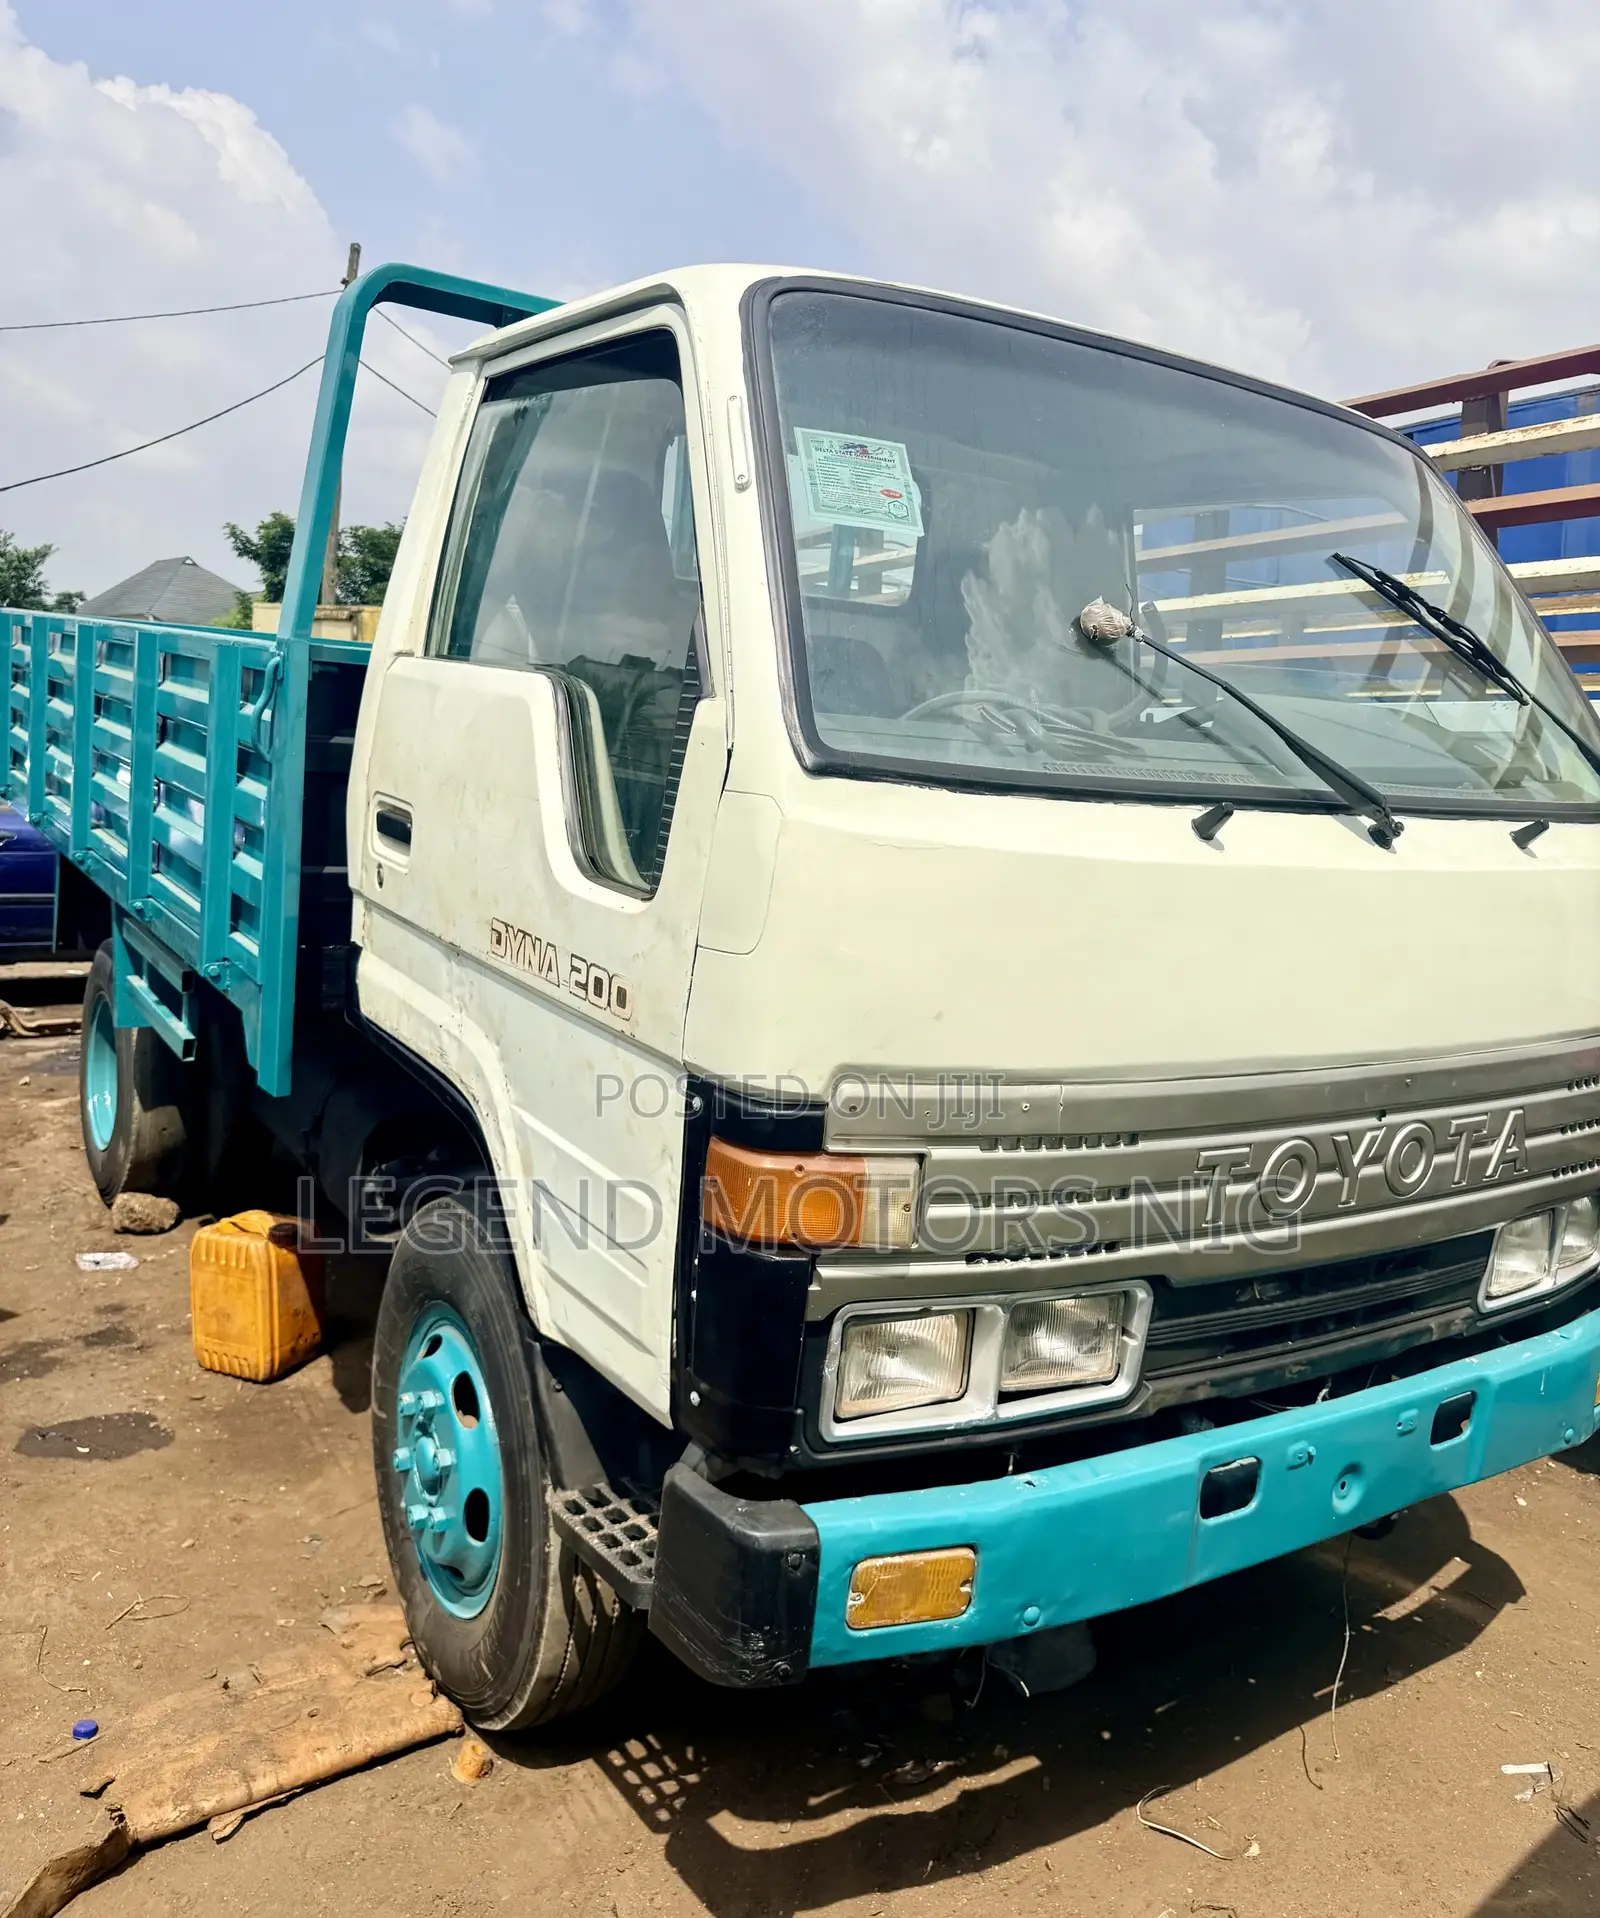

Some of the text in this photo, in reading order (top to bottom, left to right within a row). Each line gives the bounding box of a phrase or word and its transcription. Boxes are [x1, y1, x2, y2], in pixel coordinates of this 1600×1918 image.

[815, 446, 834, 454] DELTA
[834, 448, 853, 457] STATE
[854, 451, 896, 464] GOVERNMENT
[490, 916, 635, 1022] DYNA 200
[1194, 1107, 1529, 1227] TOYOTA
